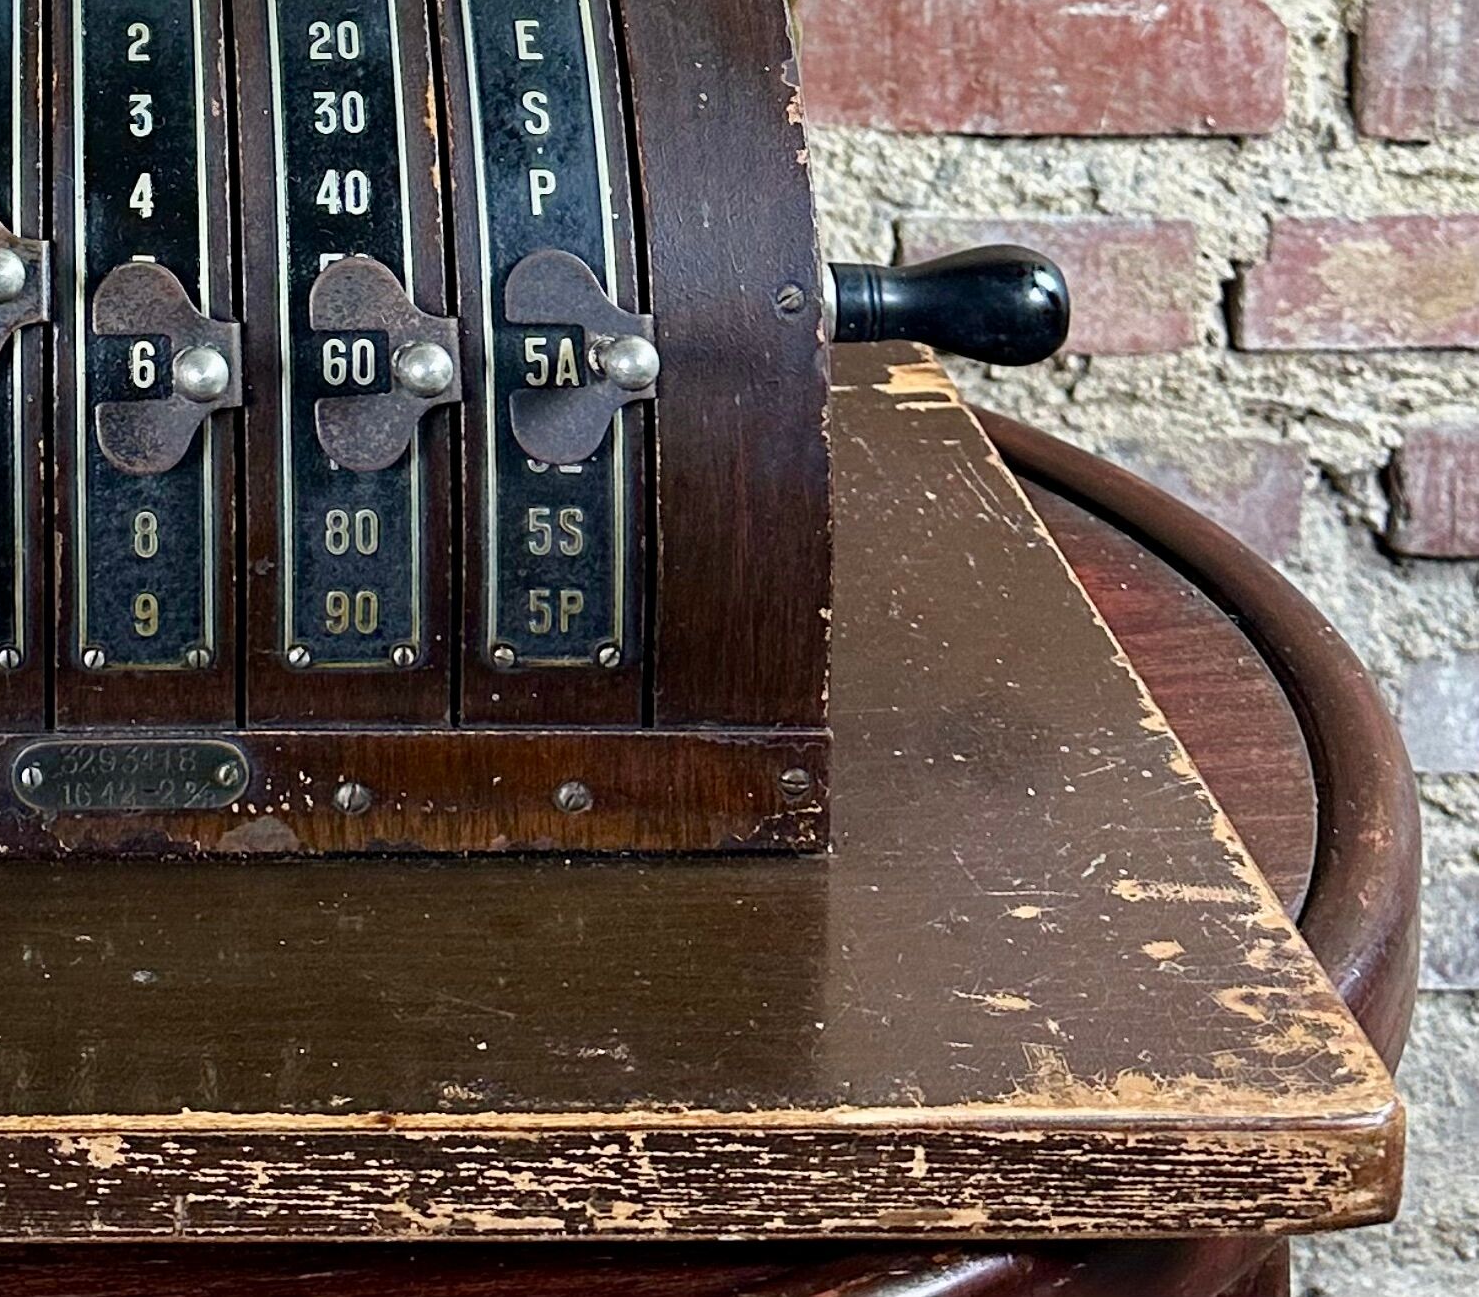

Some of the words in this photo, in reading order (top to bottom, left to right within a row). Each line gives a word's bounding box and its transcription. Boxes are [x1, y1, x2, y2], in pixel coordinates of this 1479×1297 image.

[127, 23, 150, 61] 2
[308, 20, 360, 60] 20
[514, 20, 544, 61] E
[129, 94, 153, 137] 3
[313, 91, 365, 134] 30
[522, 91, 550, 135] S
[129, 173, 154, 219] 4
[316, 169, 369, 215] 40
[528, 169, 556, 216] P
[132, 341, 155, 389] 6
[322, 338, 376, 385] 60
[524, 337, 580, 387] 5A
[134, 511, 158, 558] 8
[325, 509, 379, 555] 80
[528, 507, 584, 556] 5S
[134, 593, 159, 637] 9
[325, 590, 379, 634] 90
[528, 589, 585, 635] 5P
